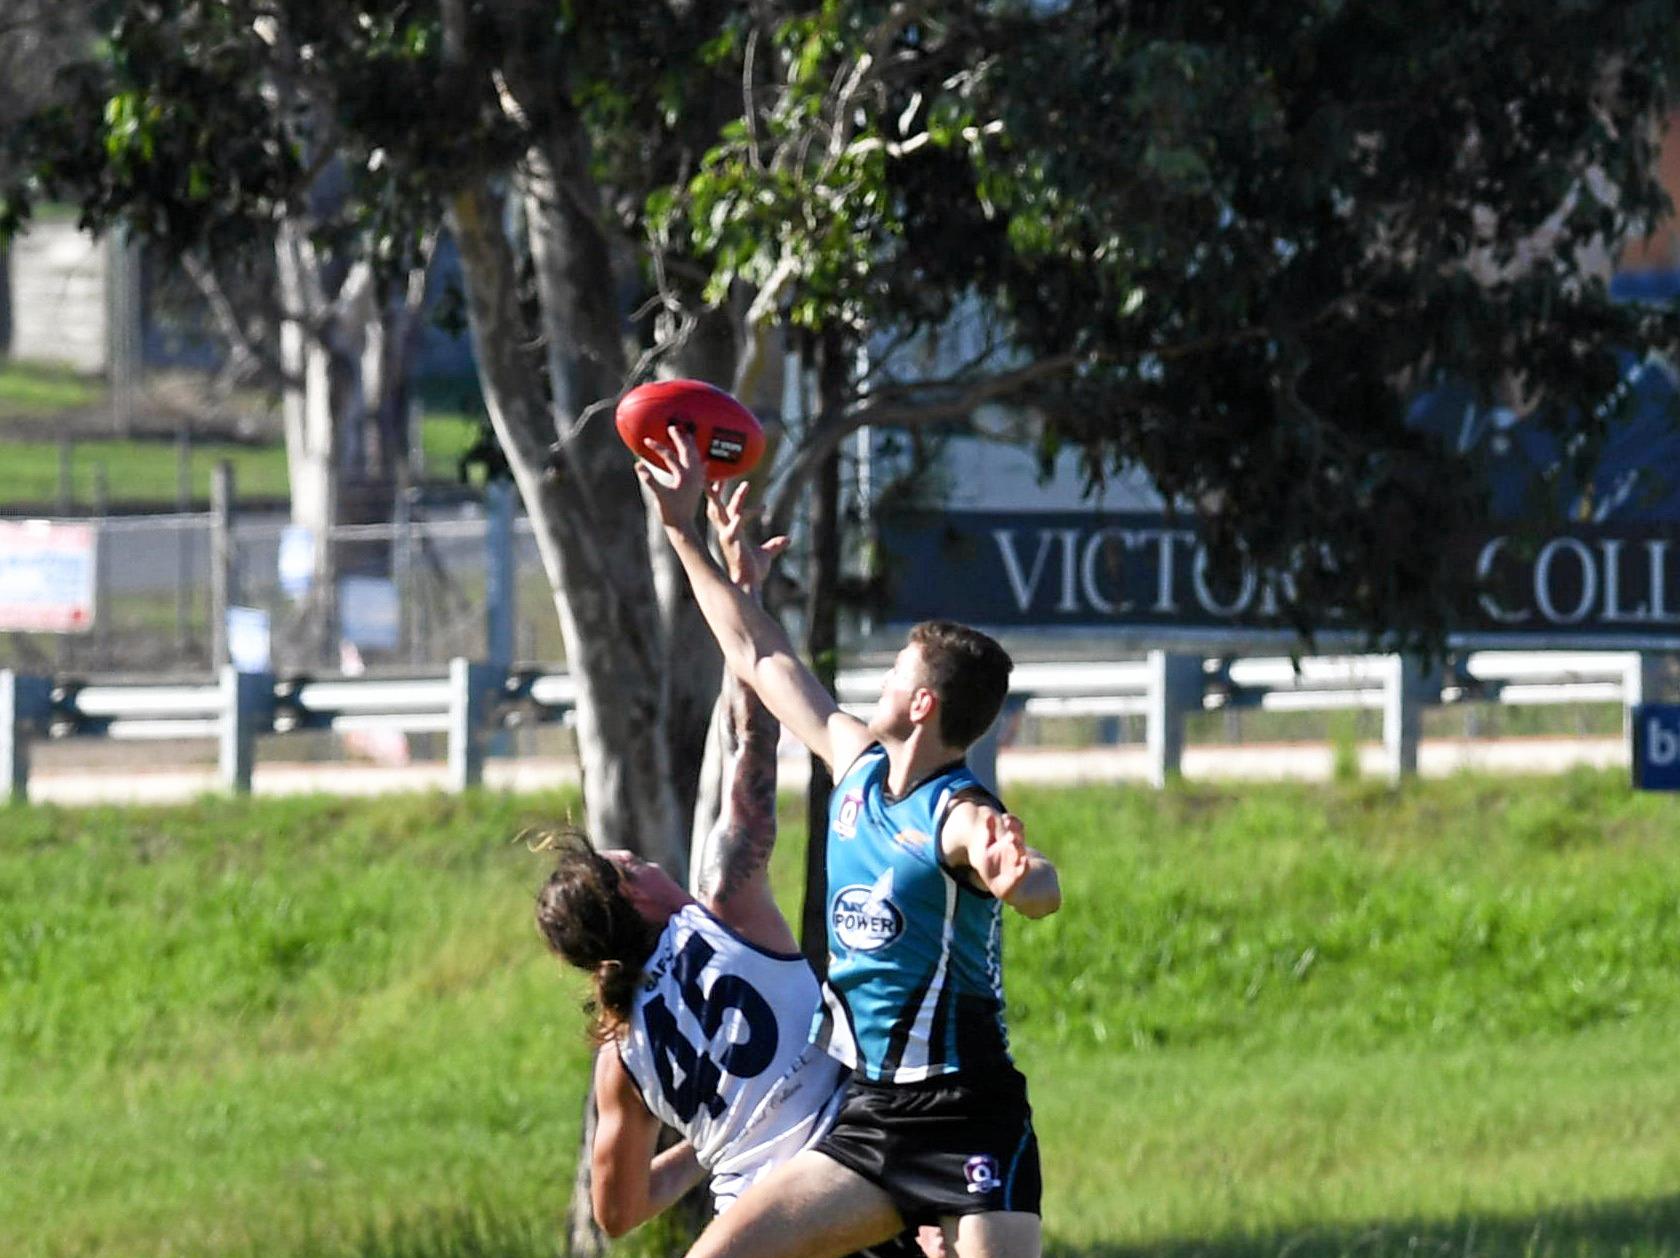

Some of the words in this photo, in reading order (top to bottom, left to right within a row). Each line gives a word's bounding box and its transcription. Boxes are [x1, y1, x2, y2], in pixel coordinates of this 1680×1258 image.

[992, 529, 1356, 618] VICTO
[835, 913, 895, 932] POWER
[643, 930, 779, 1124] 45
